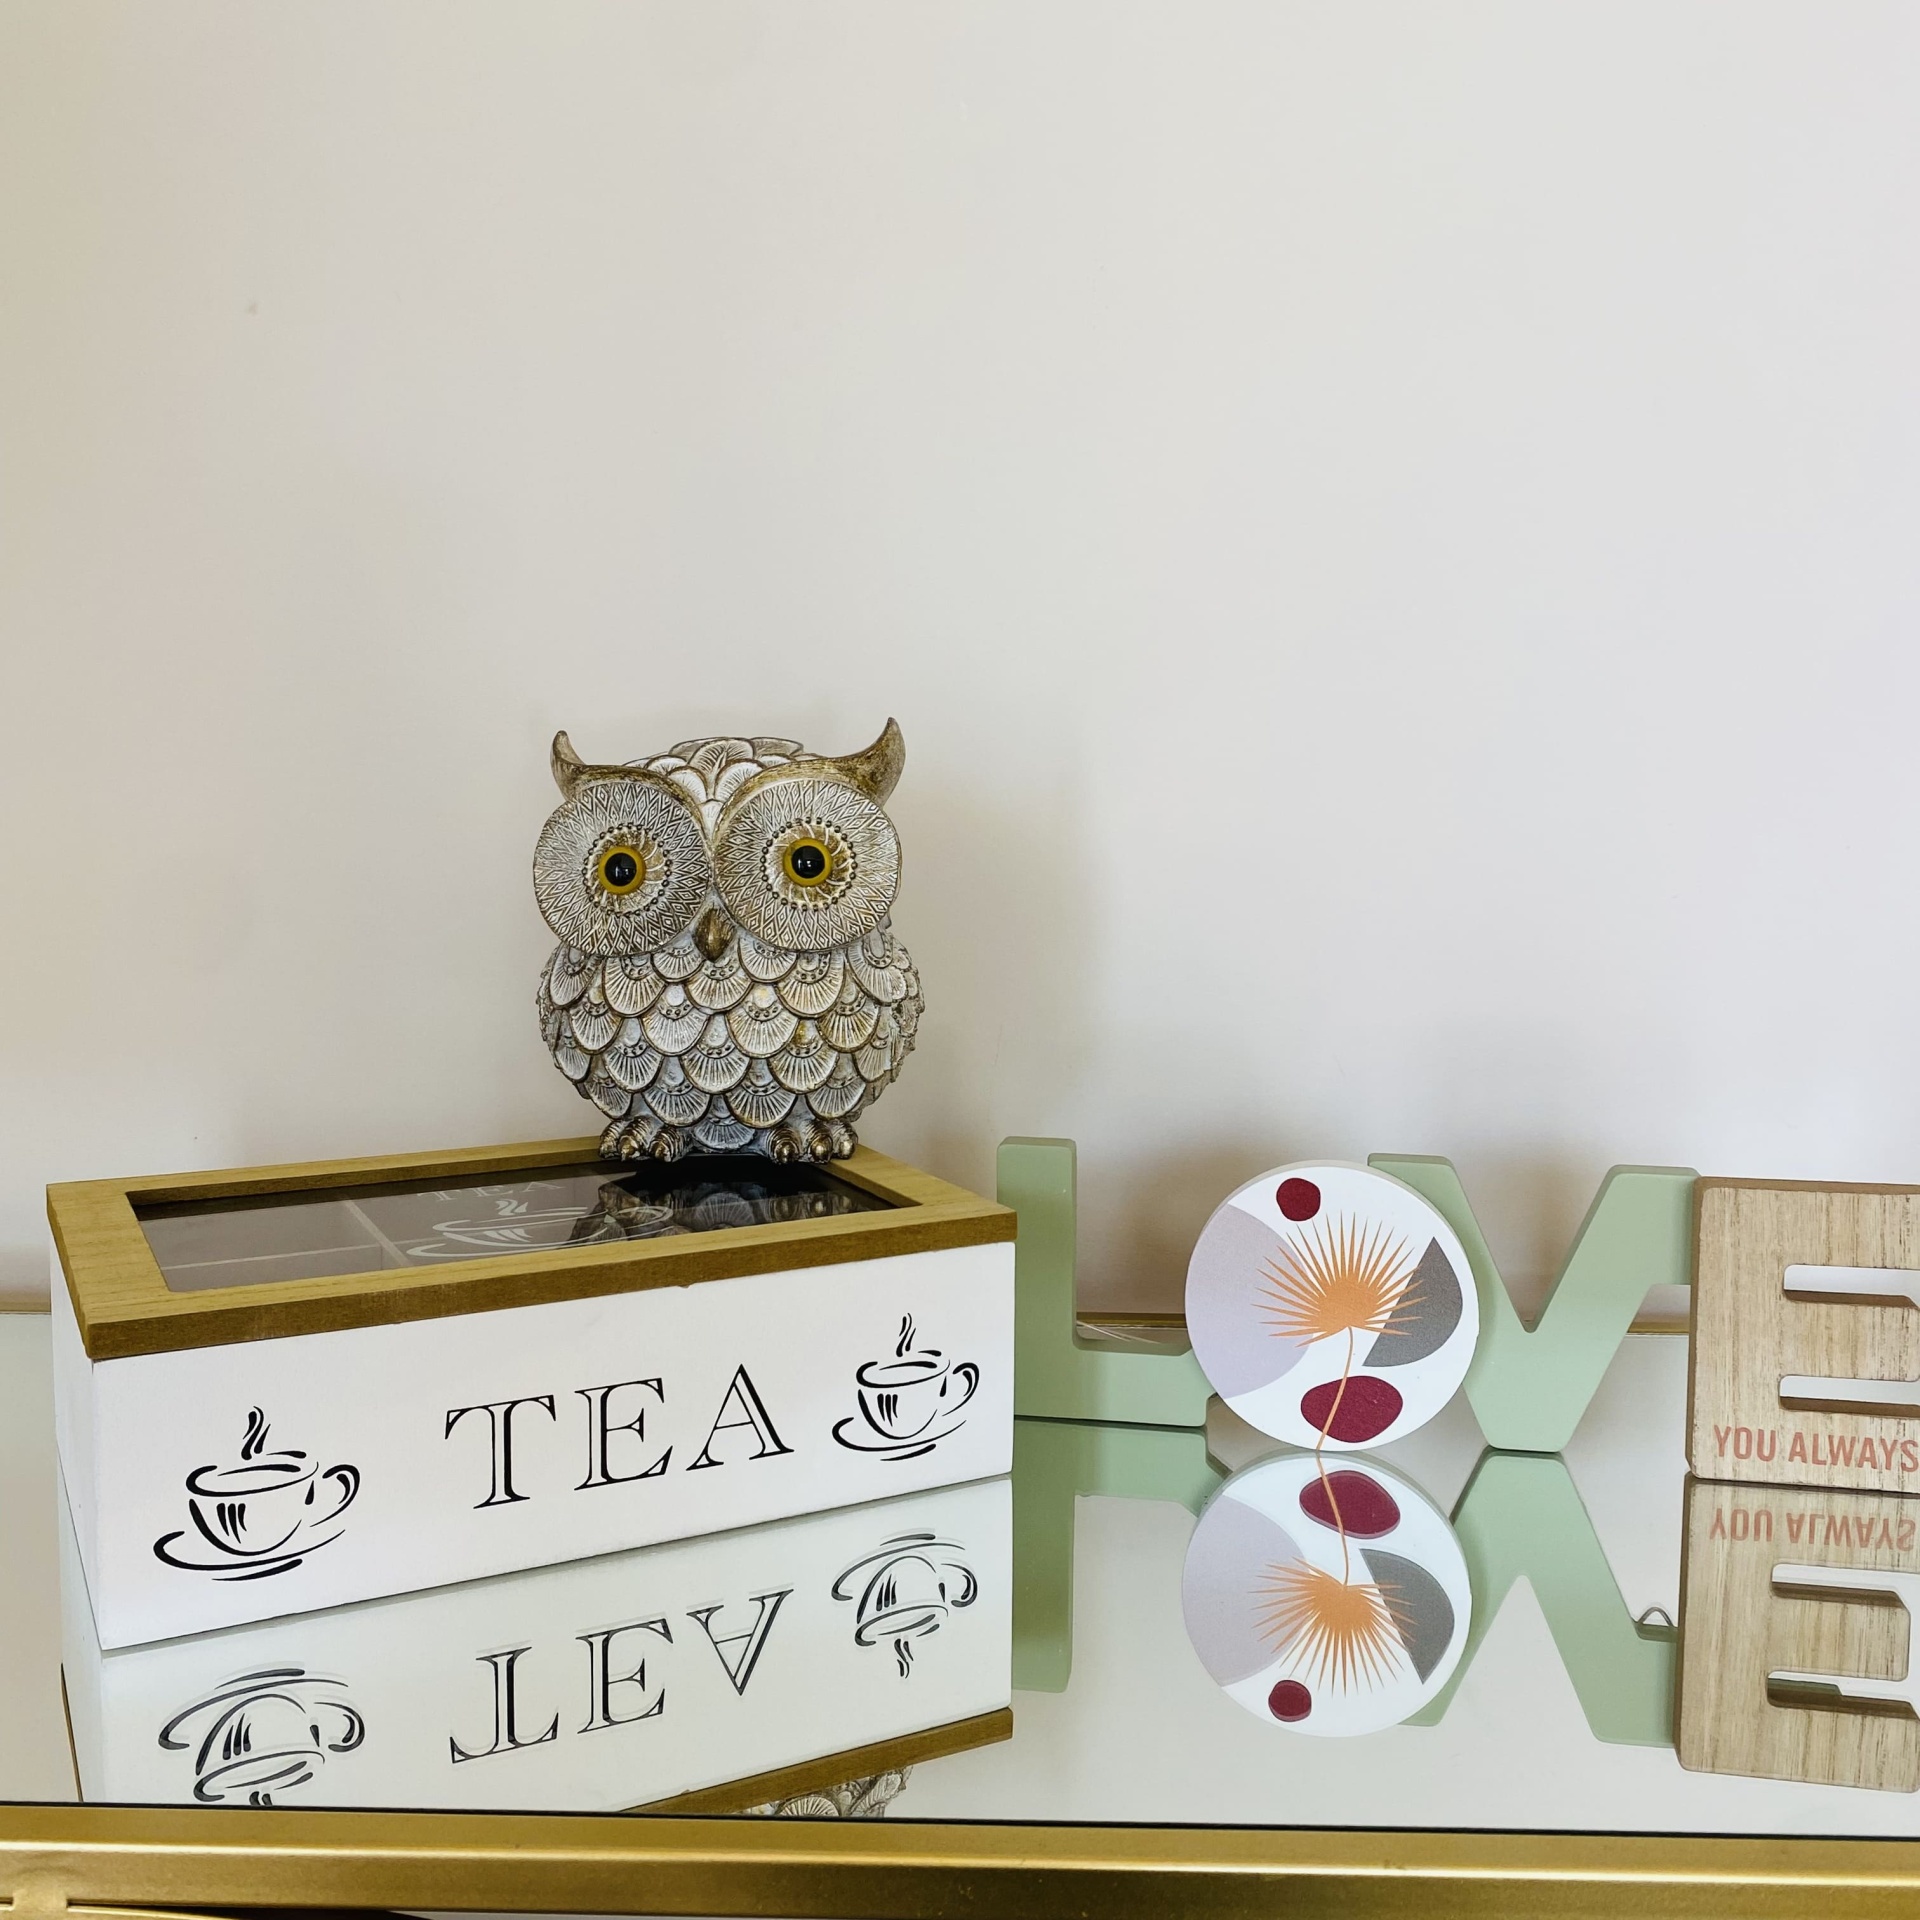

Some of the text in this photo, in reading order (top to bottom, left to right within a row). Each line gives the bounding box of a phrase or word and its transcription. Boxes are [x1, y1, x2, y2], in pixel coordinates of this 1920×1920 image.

[417, 1181, 566, 1201] TEA
[445, 1364, 794, 1509] TEA
[1714, 1425, 1919, 1472] YOU ALWAYS
